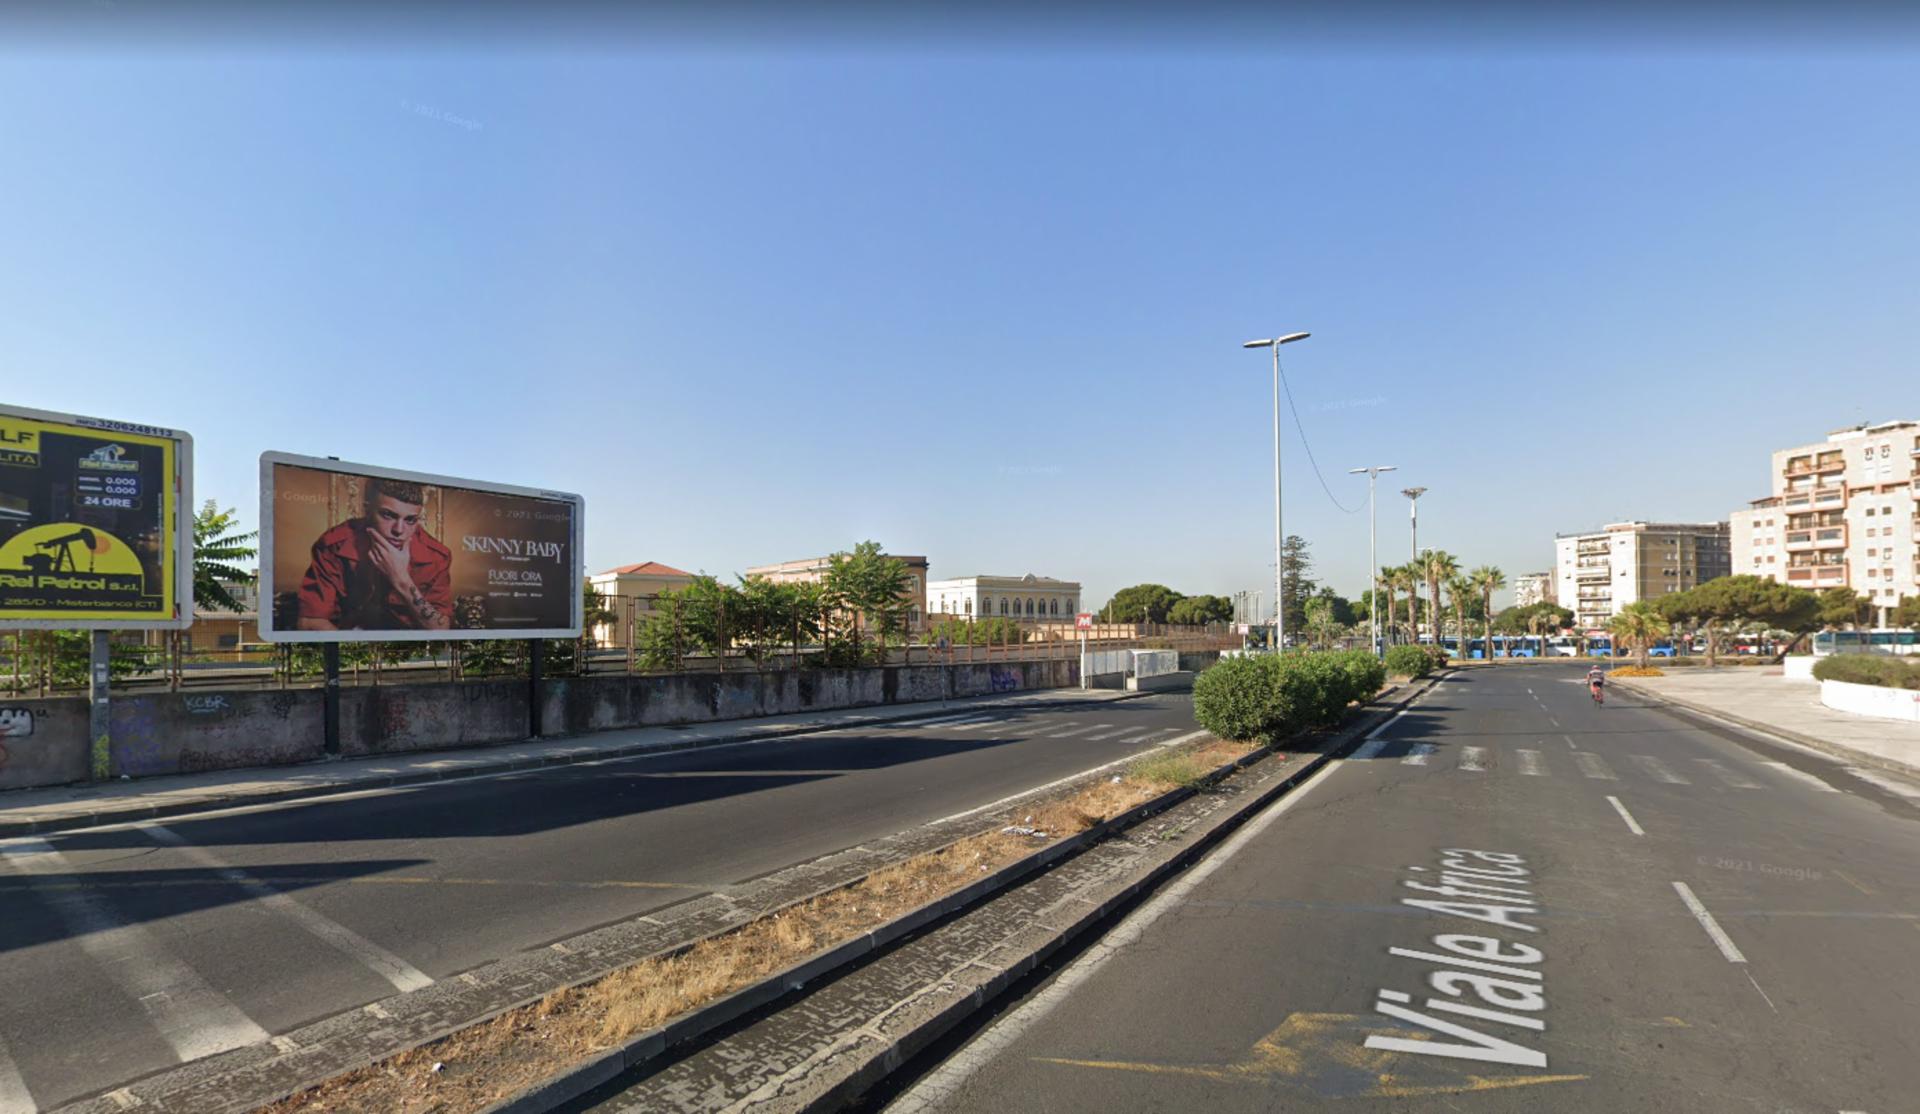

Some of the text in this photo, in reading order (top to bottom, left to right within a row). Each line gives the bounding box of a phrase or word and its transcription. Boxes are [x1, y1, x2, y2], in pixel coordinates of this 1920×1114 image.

[105, 477, 136, 486] 0.000
[105, 486, 136, 495] 0.000
[84, 496, 131, 508] 24 ORE
[462, 535, 564, 564] SKINNY BABY
[488, 569, 542, 582] FUORI ORA
[38, 576, 106, 590] Petrol
